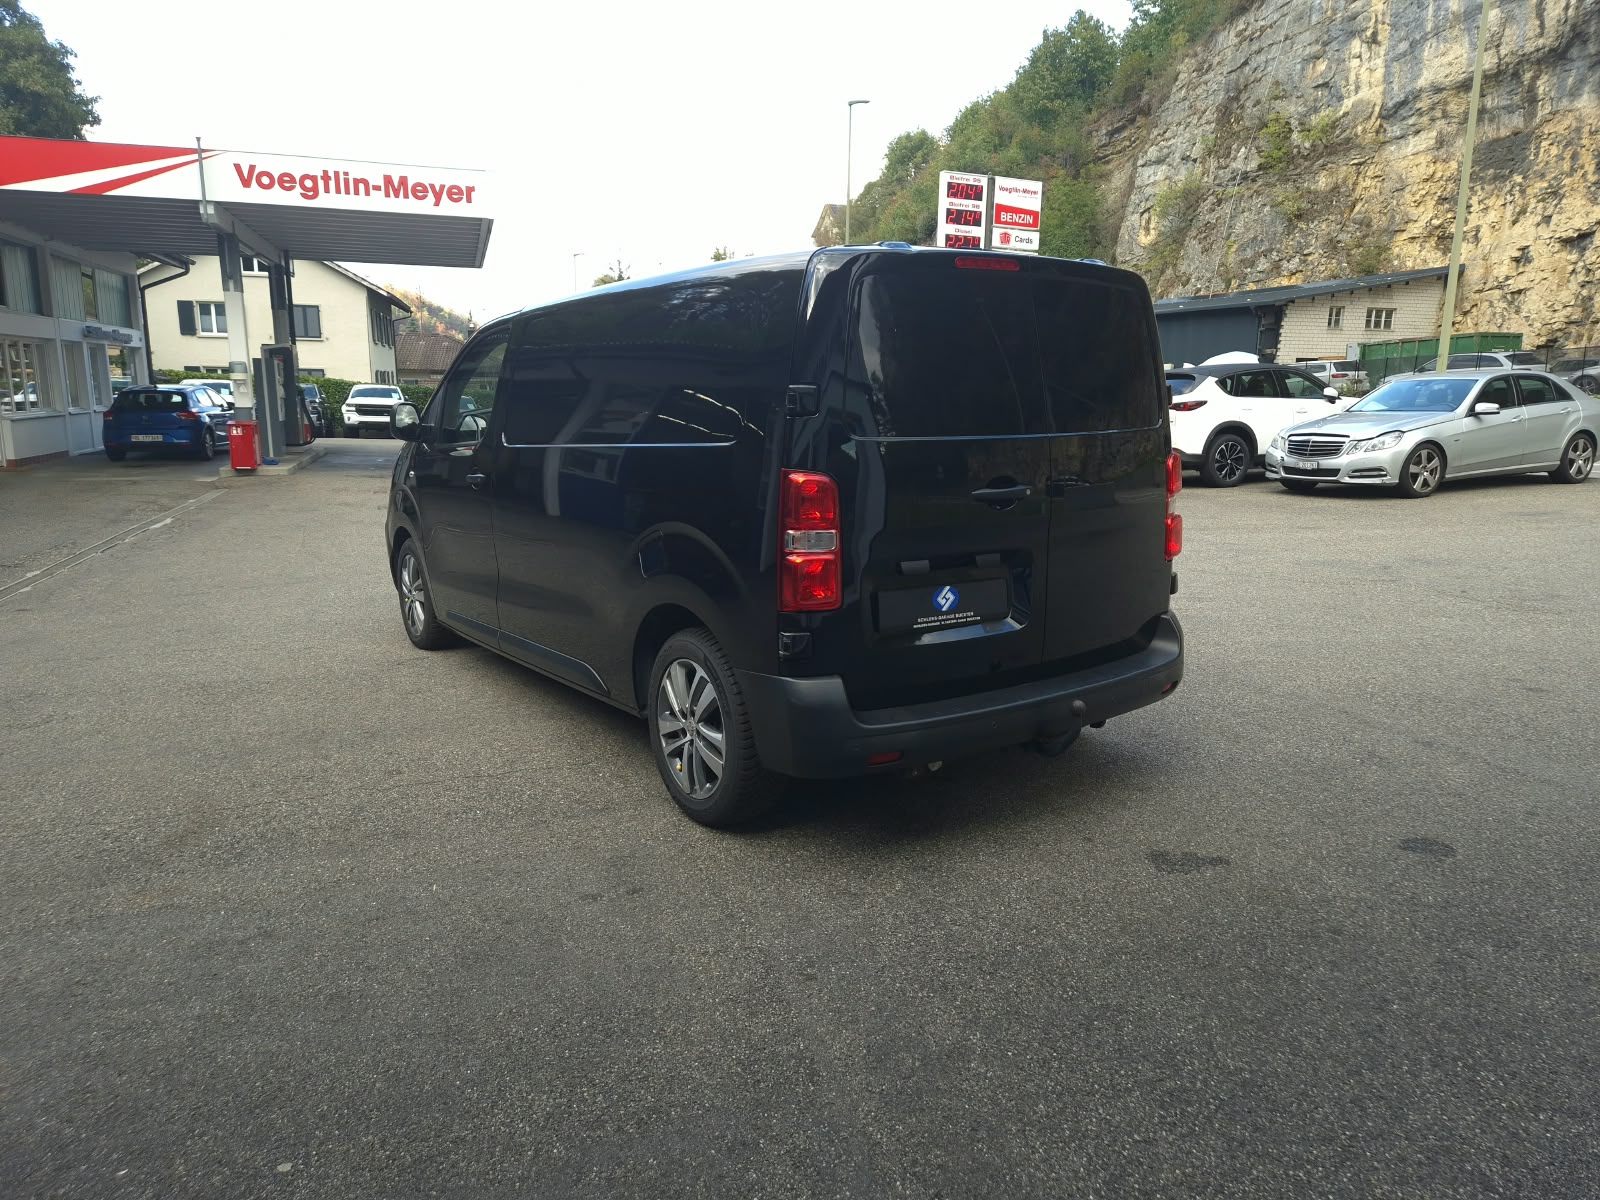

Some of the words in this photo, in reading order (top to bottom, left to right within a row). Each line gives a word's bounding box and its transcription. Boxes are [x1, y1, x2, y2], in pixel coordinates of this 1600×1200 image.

[233, 162, 475, 206] Voegtlin-Meyer
[999, 185, 1039, 195] Voegtlin-Meyer
[1000, 212, 1033, 224] BENZIN
[1014, 236, 1033, 244] Cards
